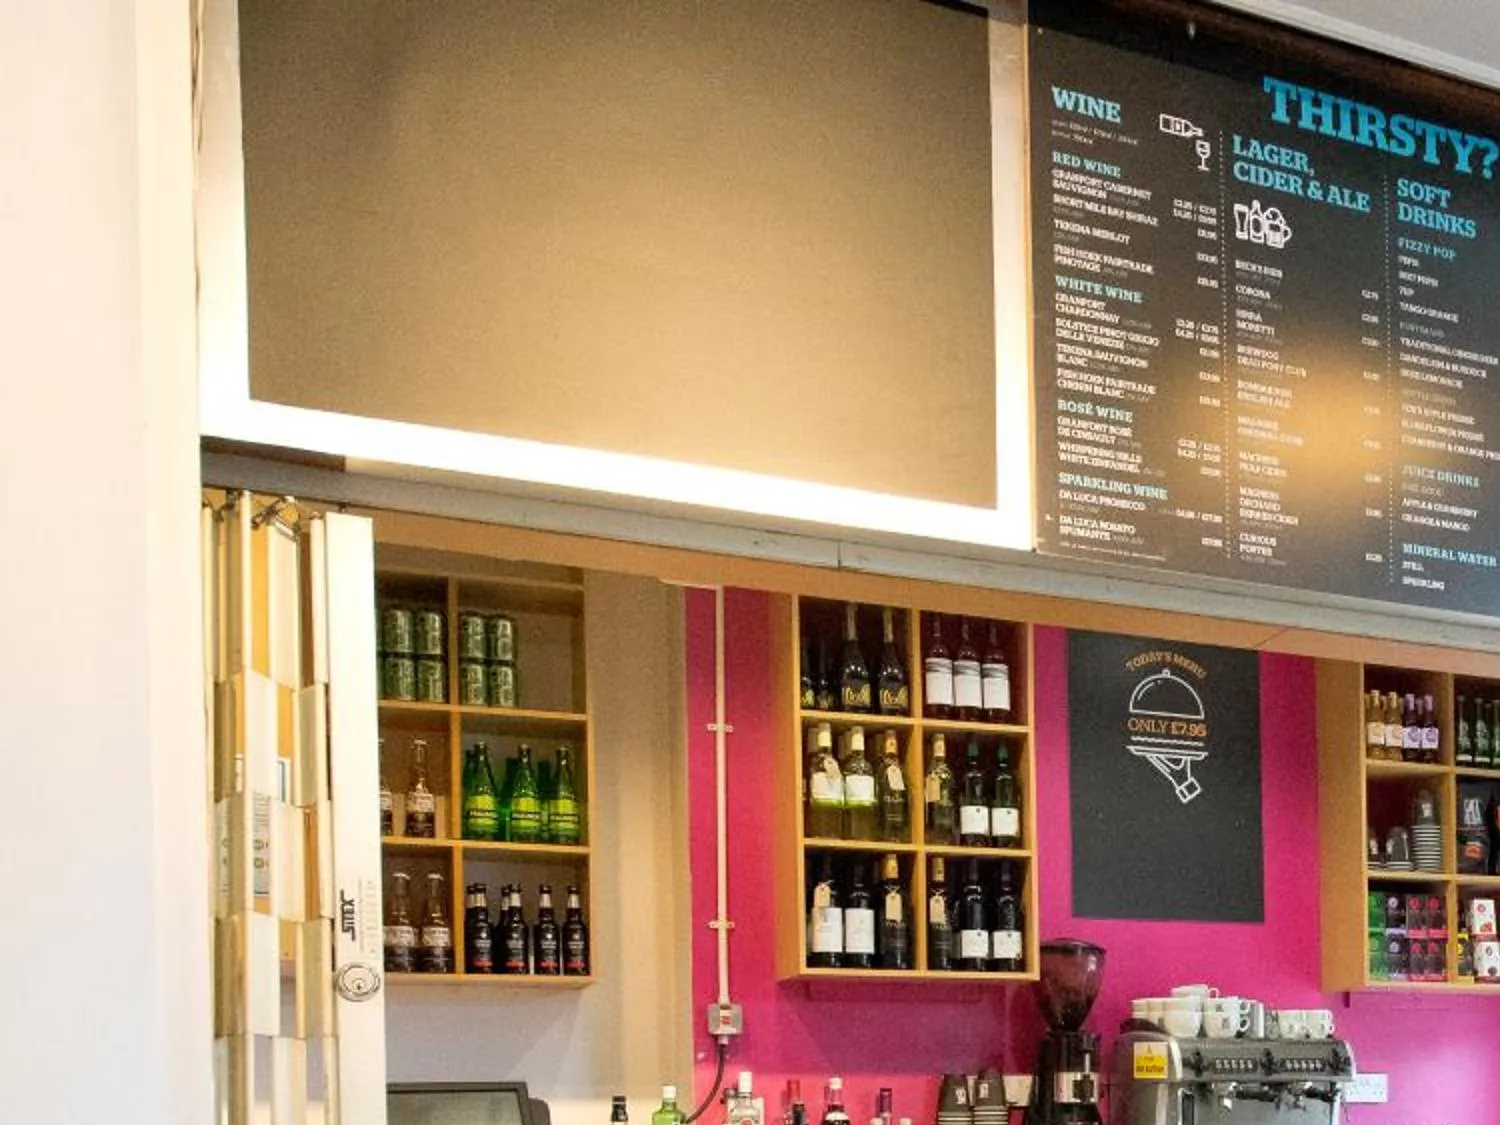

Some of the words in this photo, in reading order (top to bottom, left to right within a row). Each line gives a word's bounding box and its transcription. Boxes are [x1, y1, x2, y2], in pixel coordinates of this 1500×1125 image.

[1052, 86, 1121, 123] WINE
[1263, 76, 1500, 180] THIRSTY?
[1053, 151, 1081, 167] RED
[1084, 158, 1121, 179] WINE
[1233, 134, 1315, 176] LAGER,
[1233, 162, 1303, 197] CIDER
[1307, 180, 1323, 202] &
[1326, 184, 1371, 214] ALE
[1397, 178, 1450, 209] SOFT
[1397, 203, 1477, 239] DRINKS
[1398, 236, 1431, 254] FIZZY
[1055, 275, 1103, 295] WHITE
[1105, 284, 1143, 304] WINE
[1096, 404, 1133, 424] WINE
[1058, 472, 1132, 495] SPARKLING
[1134, 483, 1169, 501] WINE
[1437, 471, 1480, 489] DRINKS
[1403, 543, 1456, 561] MINERAL
[1458, 552, 1498, 568] WATER
[1125, 651, 1173, 672] TODAY'S
[1174, 653, 1207, 679] MENU
[1127, 717, 1168, 735] ONLY
